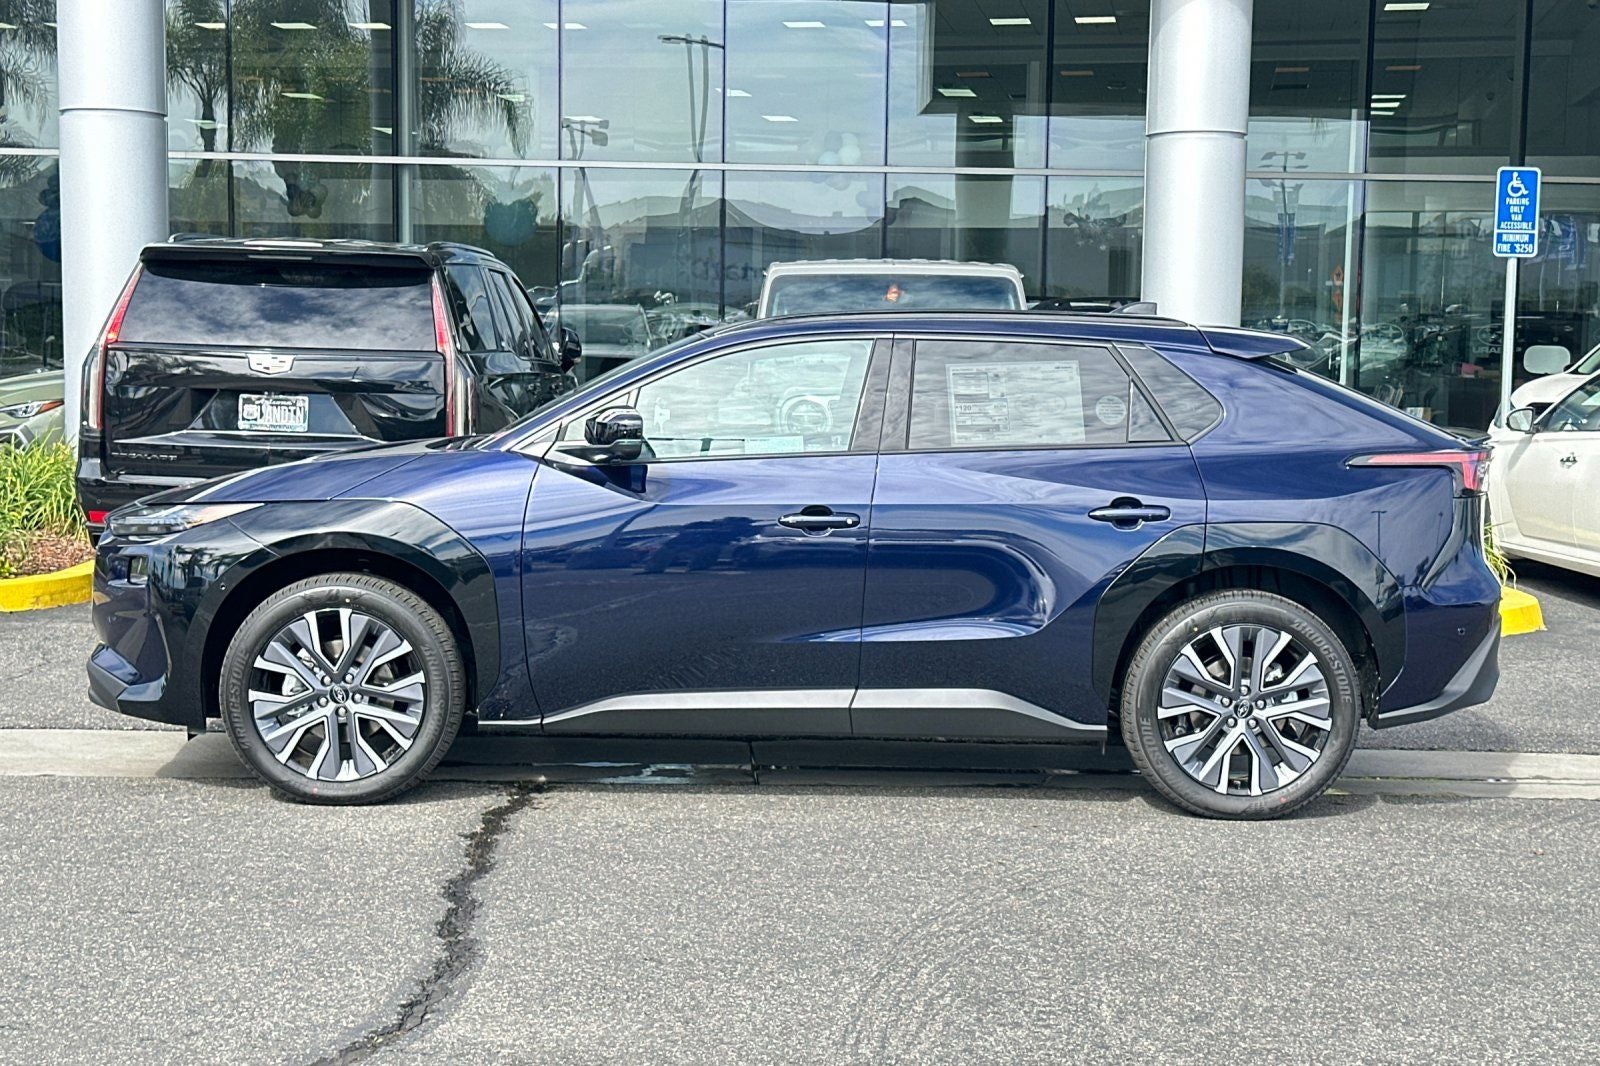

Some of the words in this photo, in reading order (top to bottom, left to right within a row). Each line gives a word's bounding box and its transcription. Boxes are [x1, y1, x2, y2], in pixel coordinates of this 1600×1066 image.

[1505, 197, 1530, 206] PARKING
[1500, 221, 1533, 230] ACCESSIBLE
[1502, 234, 1530, 243] MINIMUM
[1497, 243, 1511, 252] FINE
[1290, 619, 1352, 703] BRIDGESTONE
